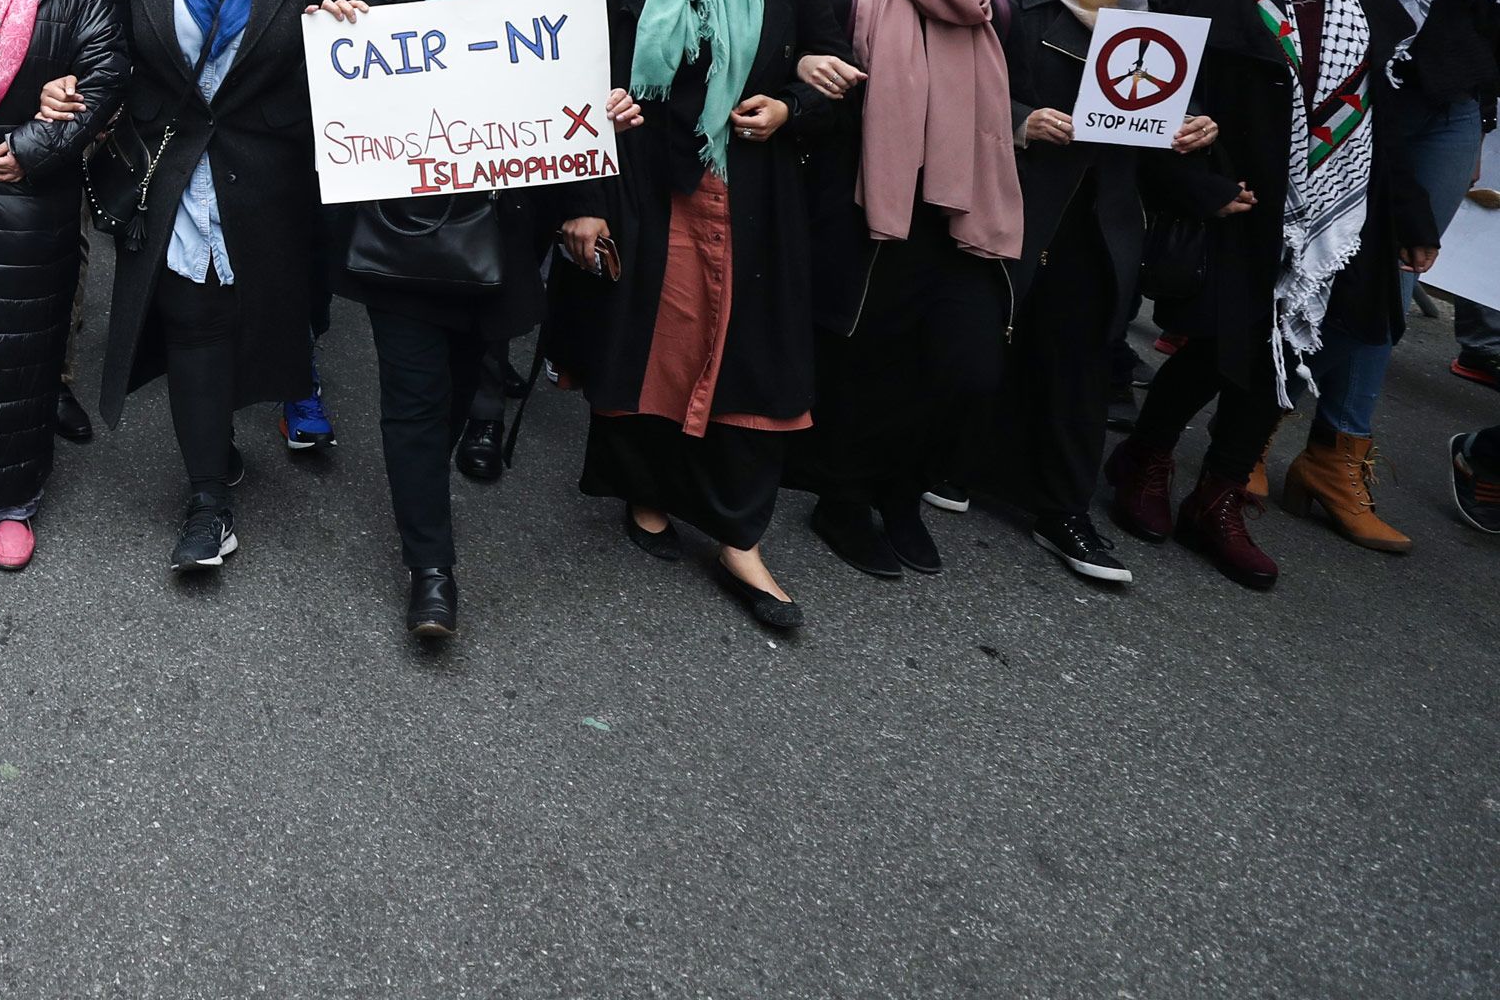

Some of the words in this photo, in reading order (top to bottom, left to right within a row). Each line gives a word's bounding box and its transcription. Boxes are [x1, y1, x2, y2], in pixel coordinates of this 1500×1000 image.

[331, 29, 448, 79] CAIR
[1085, 112, 1126, 130] STOP
[1128, 117, 1168, 135] HATE
[407, 150, 618, 194] ISLAMOPHOBIA
